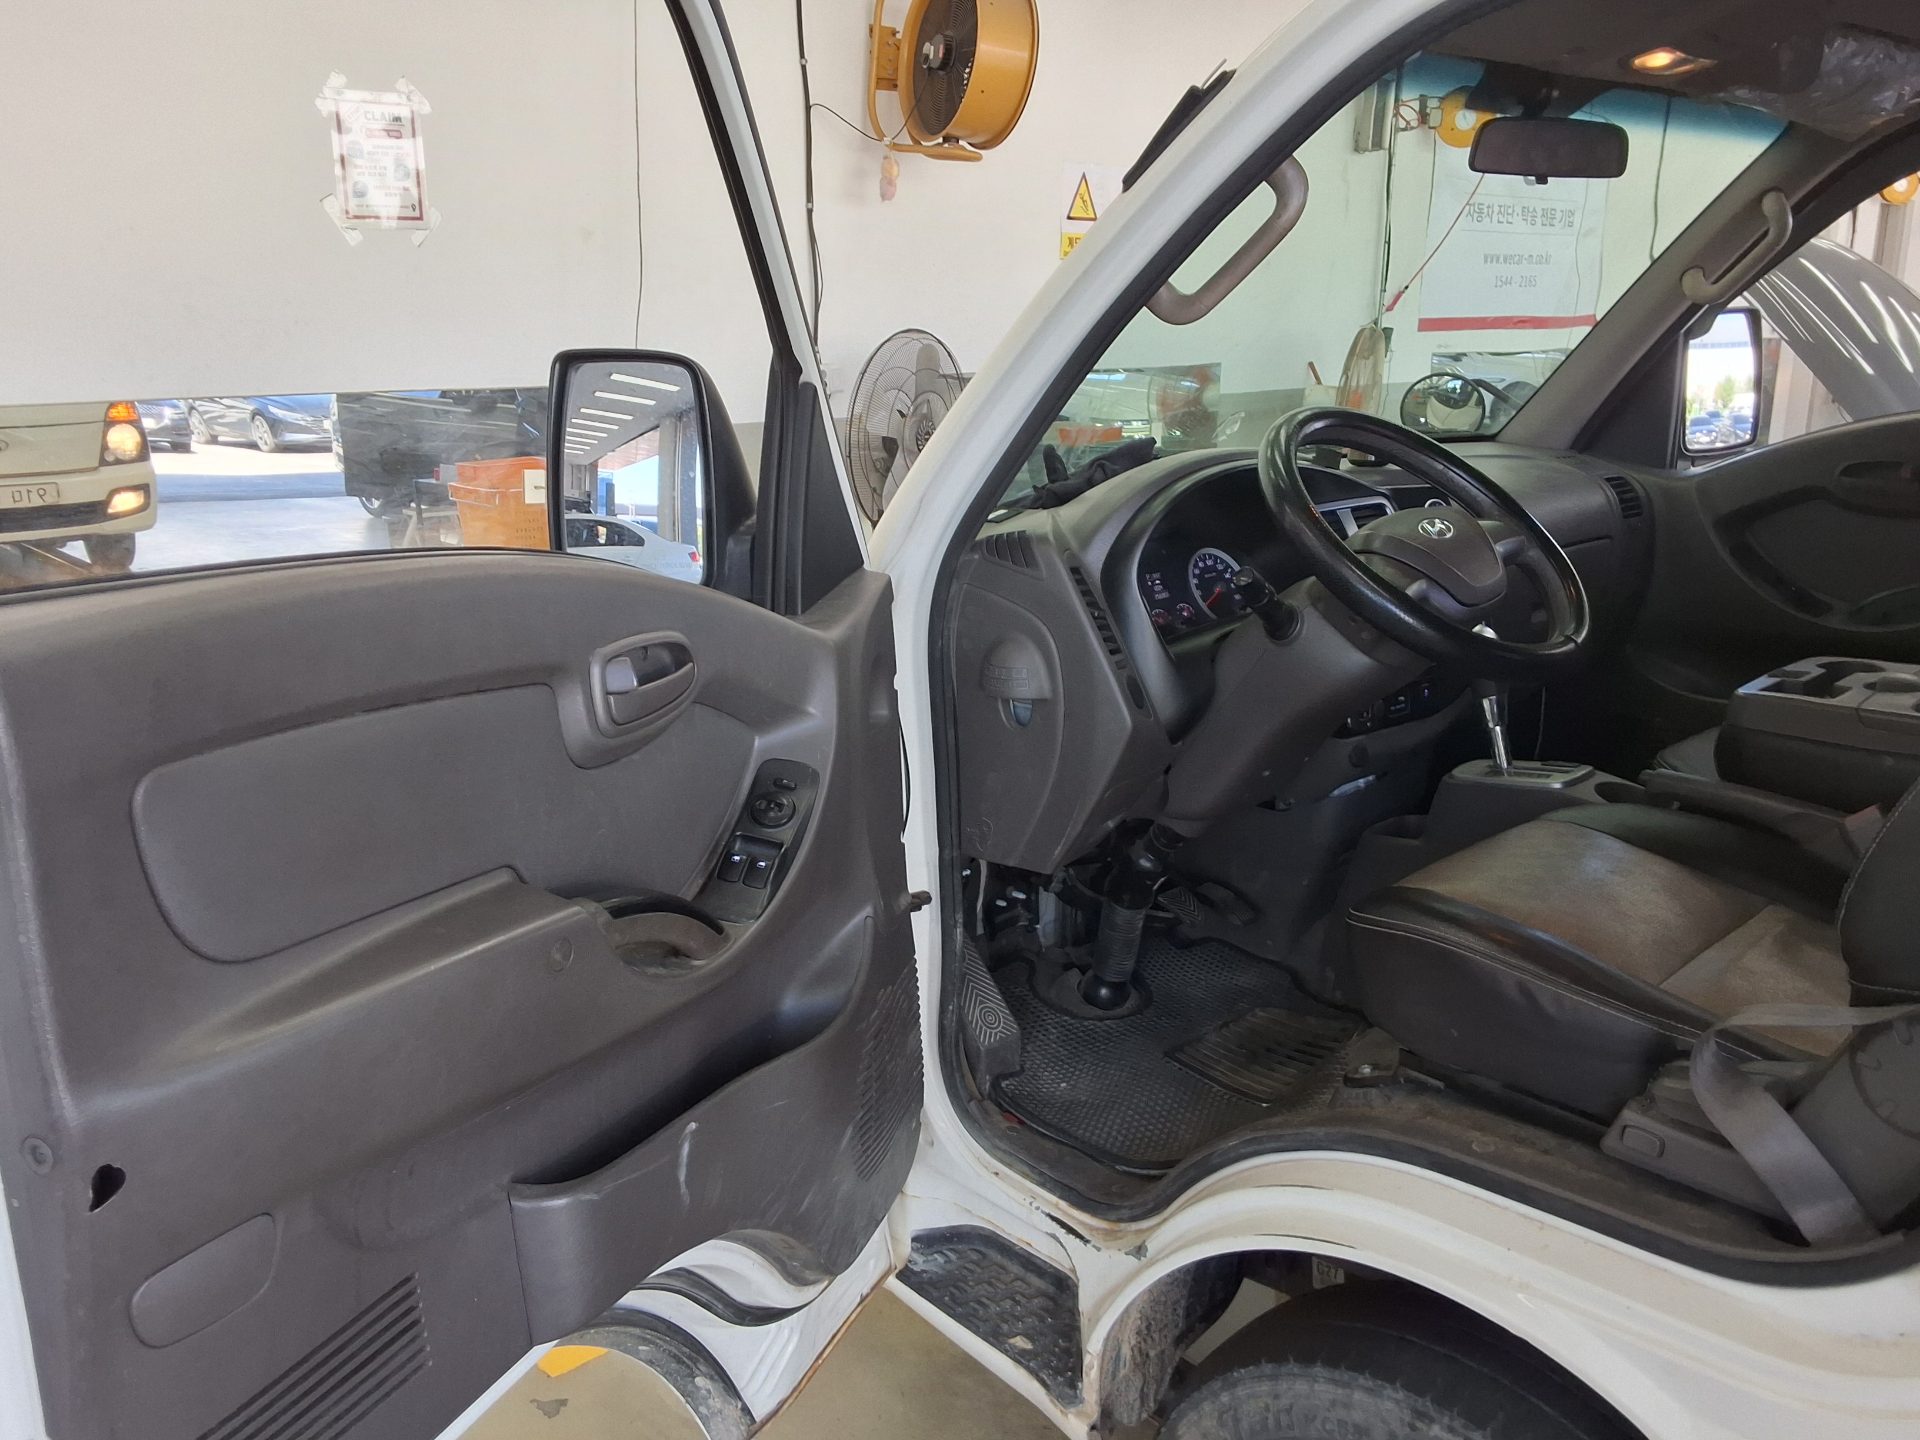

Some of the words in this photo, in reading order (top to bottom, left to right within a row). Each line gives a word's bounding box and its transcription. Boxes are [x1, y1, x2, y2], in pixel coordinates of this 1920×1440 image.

[1466, 202, 1495, 223] 자동차
[1540, 207, 1557, 227] 전문
[1558, 208, 1576, 228] 기업
